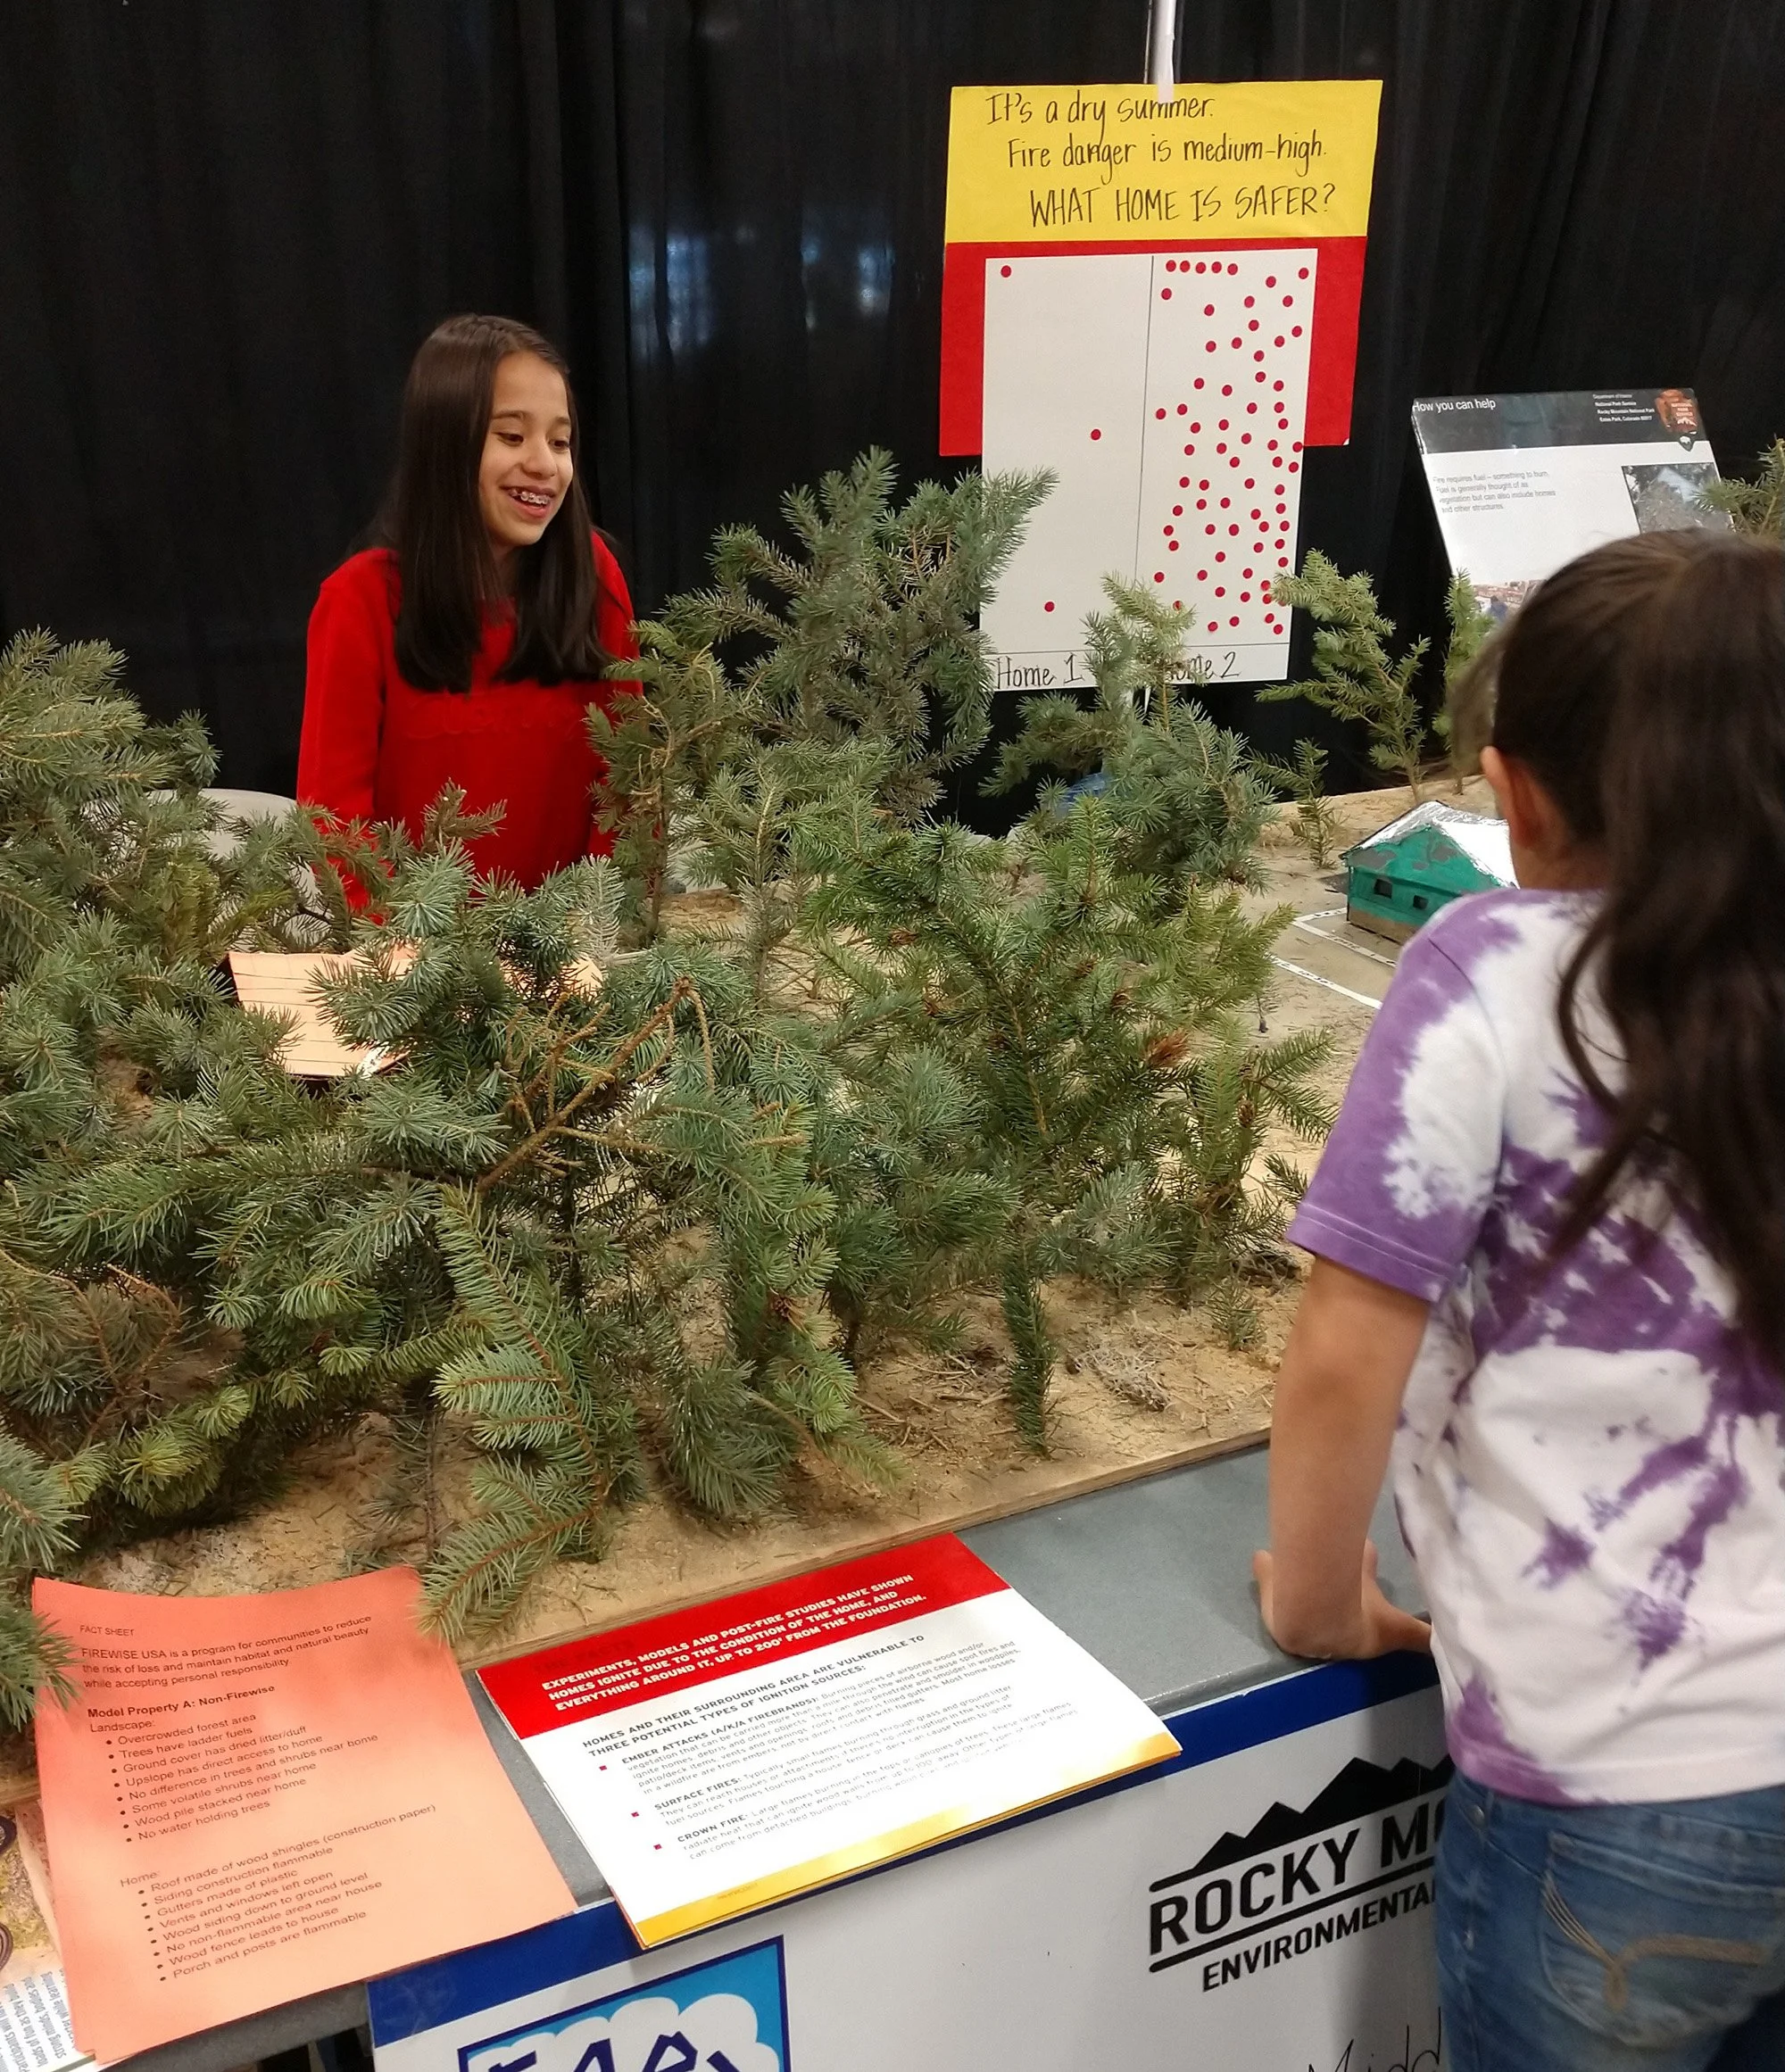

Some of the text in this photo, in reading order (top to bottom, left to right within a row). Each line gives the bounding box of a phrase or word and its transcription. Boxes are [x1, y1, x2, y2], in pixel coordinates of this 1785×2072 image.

[985, 89, 1215, 143] It's a dry summer.
[1007, 128, 1327, 185] Fire danger is medium-high.
[1029, 183, 1336, 228] WHAT HOME IS SAFER?
[1435, 401, 1454, 413] you
[1456, 401, 1474, 410] can
[1474, 398, 1496, 410] help
[997, 652, 1083, 688] Home 1
[1219, 651, 1241, 679] 2
[81, 1616, 371, 1660] FIREWISE program communities reduce
[186, 1627, 369, 1669] maintain habitat natural beauty
[541, 1574, 914, 1690] EXPERIMENTS, MODELS AND POST-FIRE STUDIES HAVE SHOWN
[548, 1591, 898, 1700] HOMES IGNITE DUE TO THE CONDITION OF THE HOME, AND
[554, 1680, 640, 1711] EVERYTHING
[643, 1664, 695, 1685] AROUND
[734, 1646, 753, 1656] TO
[785, 1626, 821, 1642] FROM
[820, 1617, 848, 1629] THE
[847, 1594, 926, 1621] FOUNDATION.
[115, 1659, 289, 1688] accepting personal responsibility
[582, 1729, 625, 1747] HOMES
[628, 1721, 652, 1734] AND
[654, 1709, 692, 1724] THEIR
[693, 1682, 776, 1712] SURROUNDING
[779, 1672, 809, 1686] AREA
[813, 1663, 834, 1675] ARE
[836, 1640, 909, 1666] VULNERABLE
[87, 1686, 275, 1718] Model Property Non-Firewise
[588, 1665, 866, 1756] THREE POTENTIAL TYPES OF IGNITION SOURCES:
[117, 1720, 228, 1745] Overcrowded forest
[120, 1734, 223, 1759] Trees have ladder
[621, 1748, 659, 1764] EMBER
[662, 1732, 709, 1752] ATTACKS
[122, 1752, 201, 1772] Ground cover
[125, 1747, 276, 1787] Upslope direct access
[149, 1750, 317, 1795] difference trees shrubs
[131, 1778, 253, 1813] Some shrubs
[134, 1793, 243, 1827] Wood stacked
[158, 1800, 270, 1835] water holding trees
[654, 1789, 703, 1810] SURFACE
[150, 1804, 436, 1892] Roof made wood shingles (construction paper)
[677, 1824, 718, 1842] CROWN
[154, 1847, 333, 1904] Siding construction flammable
[156, 1869, 297, 1916] Gutters plastic
[1150, 1828, 1361, 1955] ROCKY
[159, 1888, 279, 1928] Vents windows
[162, 1881, 337, 1941] Wood siding ground
[188, 1881, 382, 1946] non-flammable house
[168, 1907, 339, 1966] Wood fence house
[172, 1911, 366, 1978] Porch flammable
